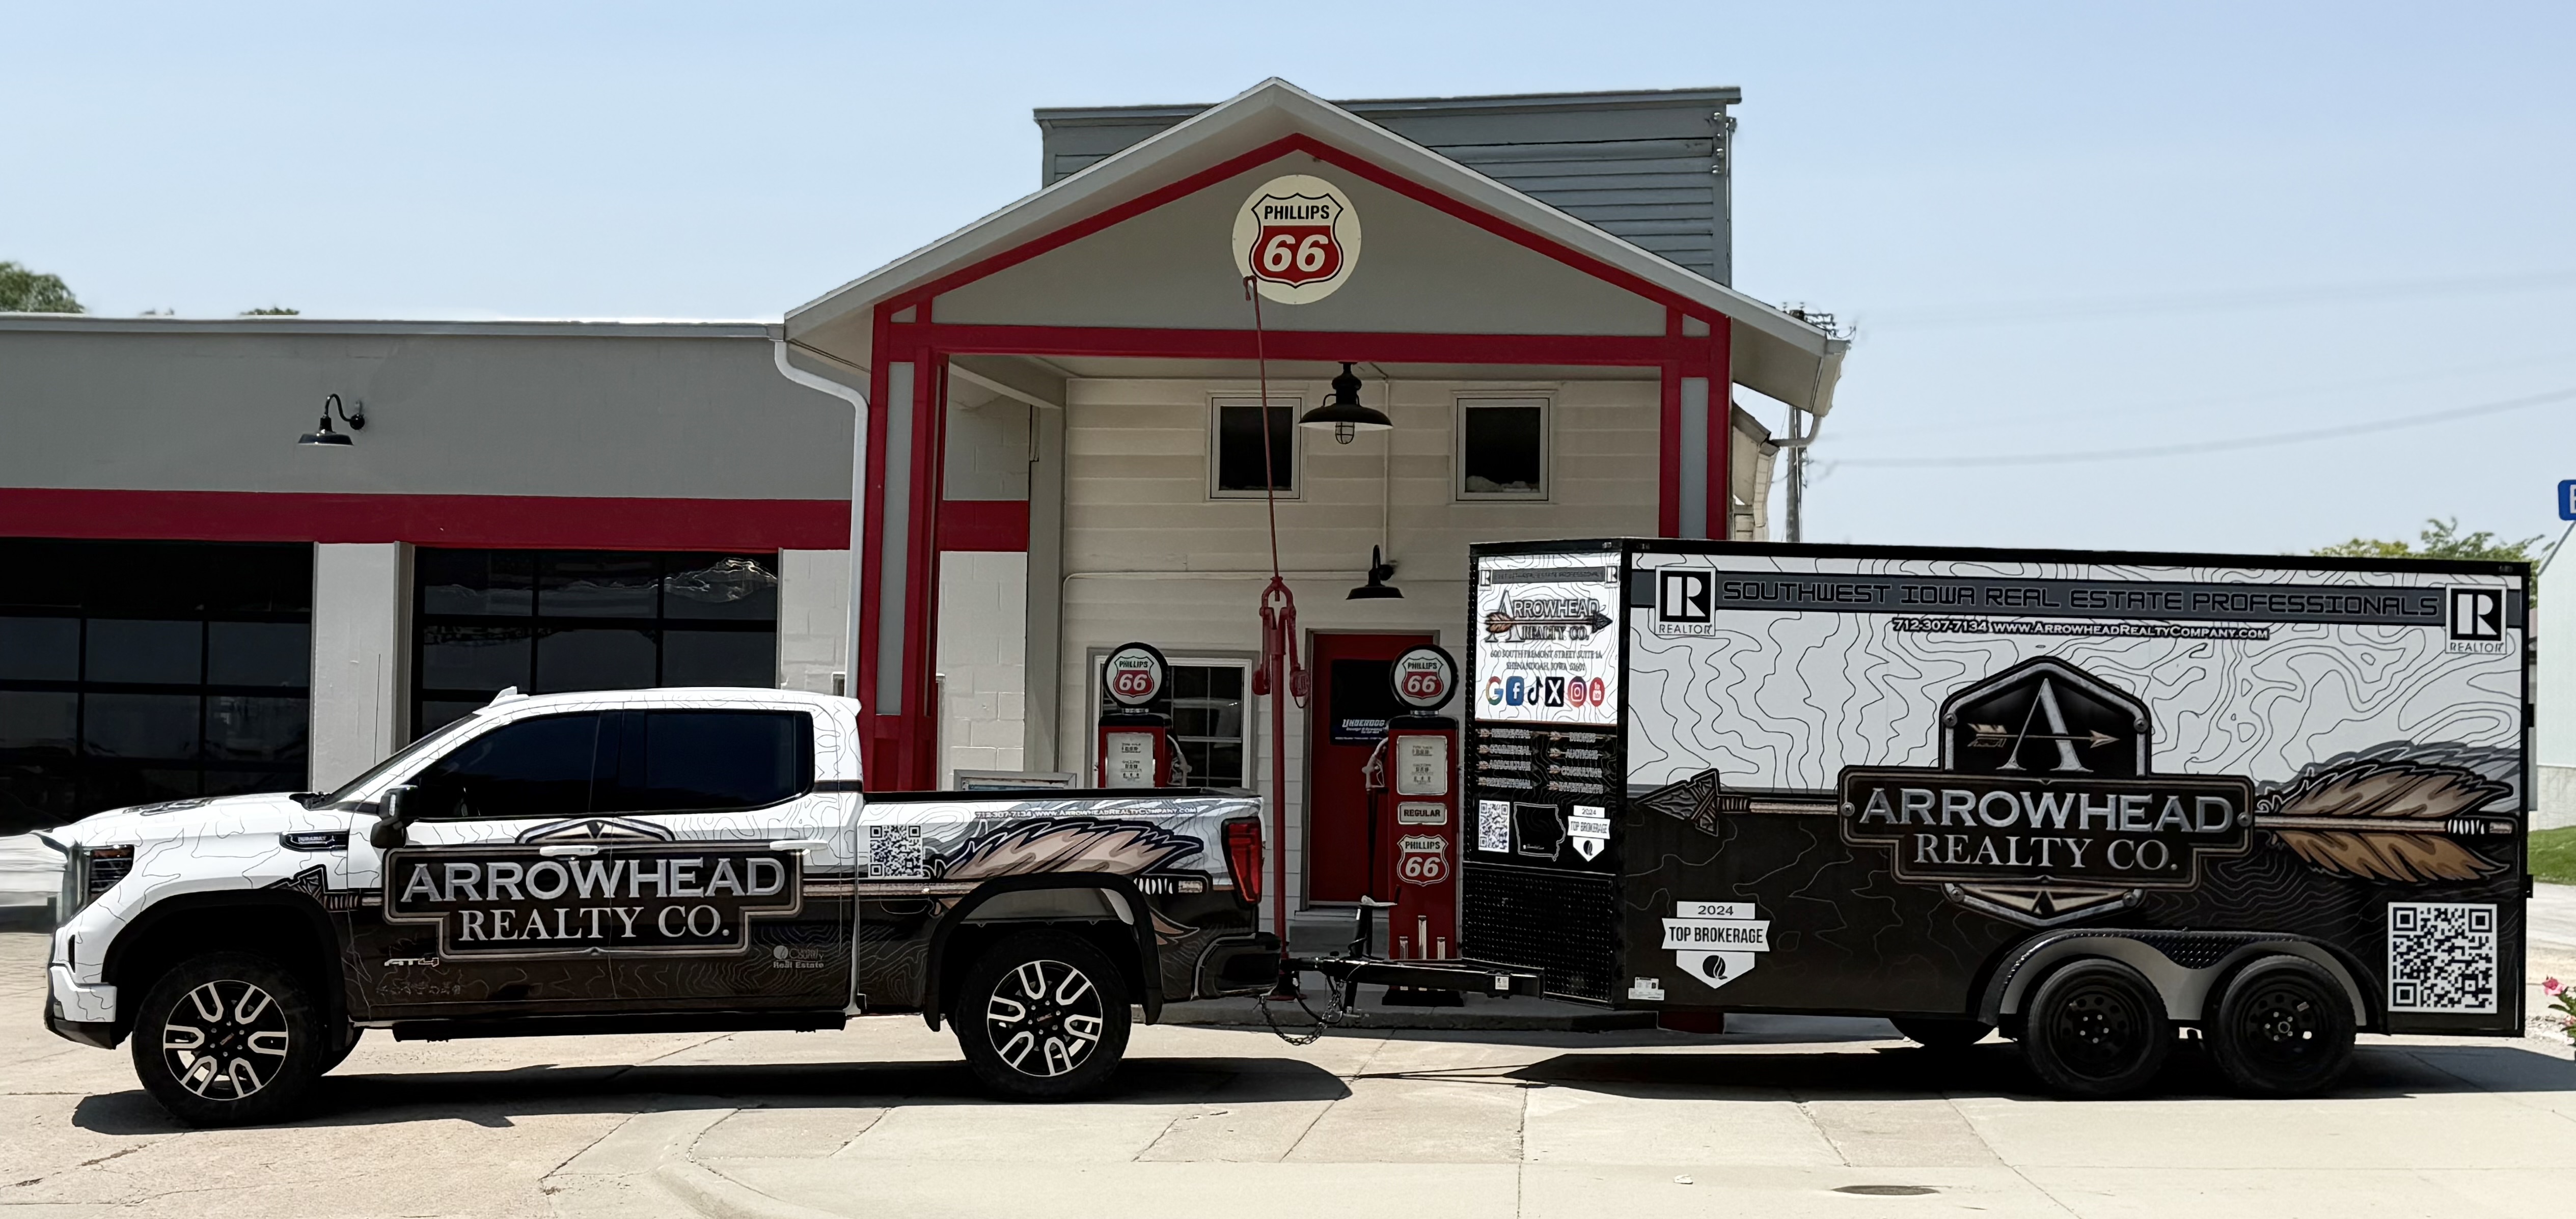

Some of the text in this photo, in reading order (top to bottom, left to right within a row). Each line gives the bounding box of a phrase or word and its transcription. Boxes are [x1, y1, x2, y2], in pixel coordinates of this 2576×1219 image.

[1265, 205, 1329, 219] PHILLIPS
[1264, 234, 1328, 272] 66
[1723, 581, 2439, 617] SOUTHWEST IOWA REAL ESTATE PROFESSIONALS
[1894, 619, 1987, 632] 712-307-7134
[1119, 674, 1148, 691] 66
[1408, 675, 1437, 692] 66
[1995, 678, 2094, 773] A
[1859, 787, 2234, 834] ARROWHEAD
[1405, 841, 1440, 849] PHILLIPS
[1913, 834, 2178, 871] REALTY CO.
[1405, 856, 1441, 877] 66
[400, 857, 785, 902] ARROWHEAD
[1697, 905, 1734, 916] 2024
[458, 904, 730, 941] REALTY CO.
[1669, 926, 1764, 944] TOP BROKERAGE
[384, 957, 439, 967] AT4
